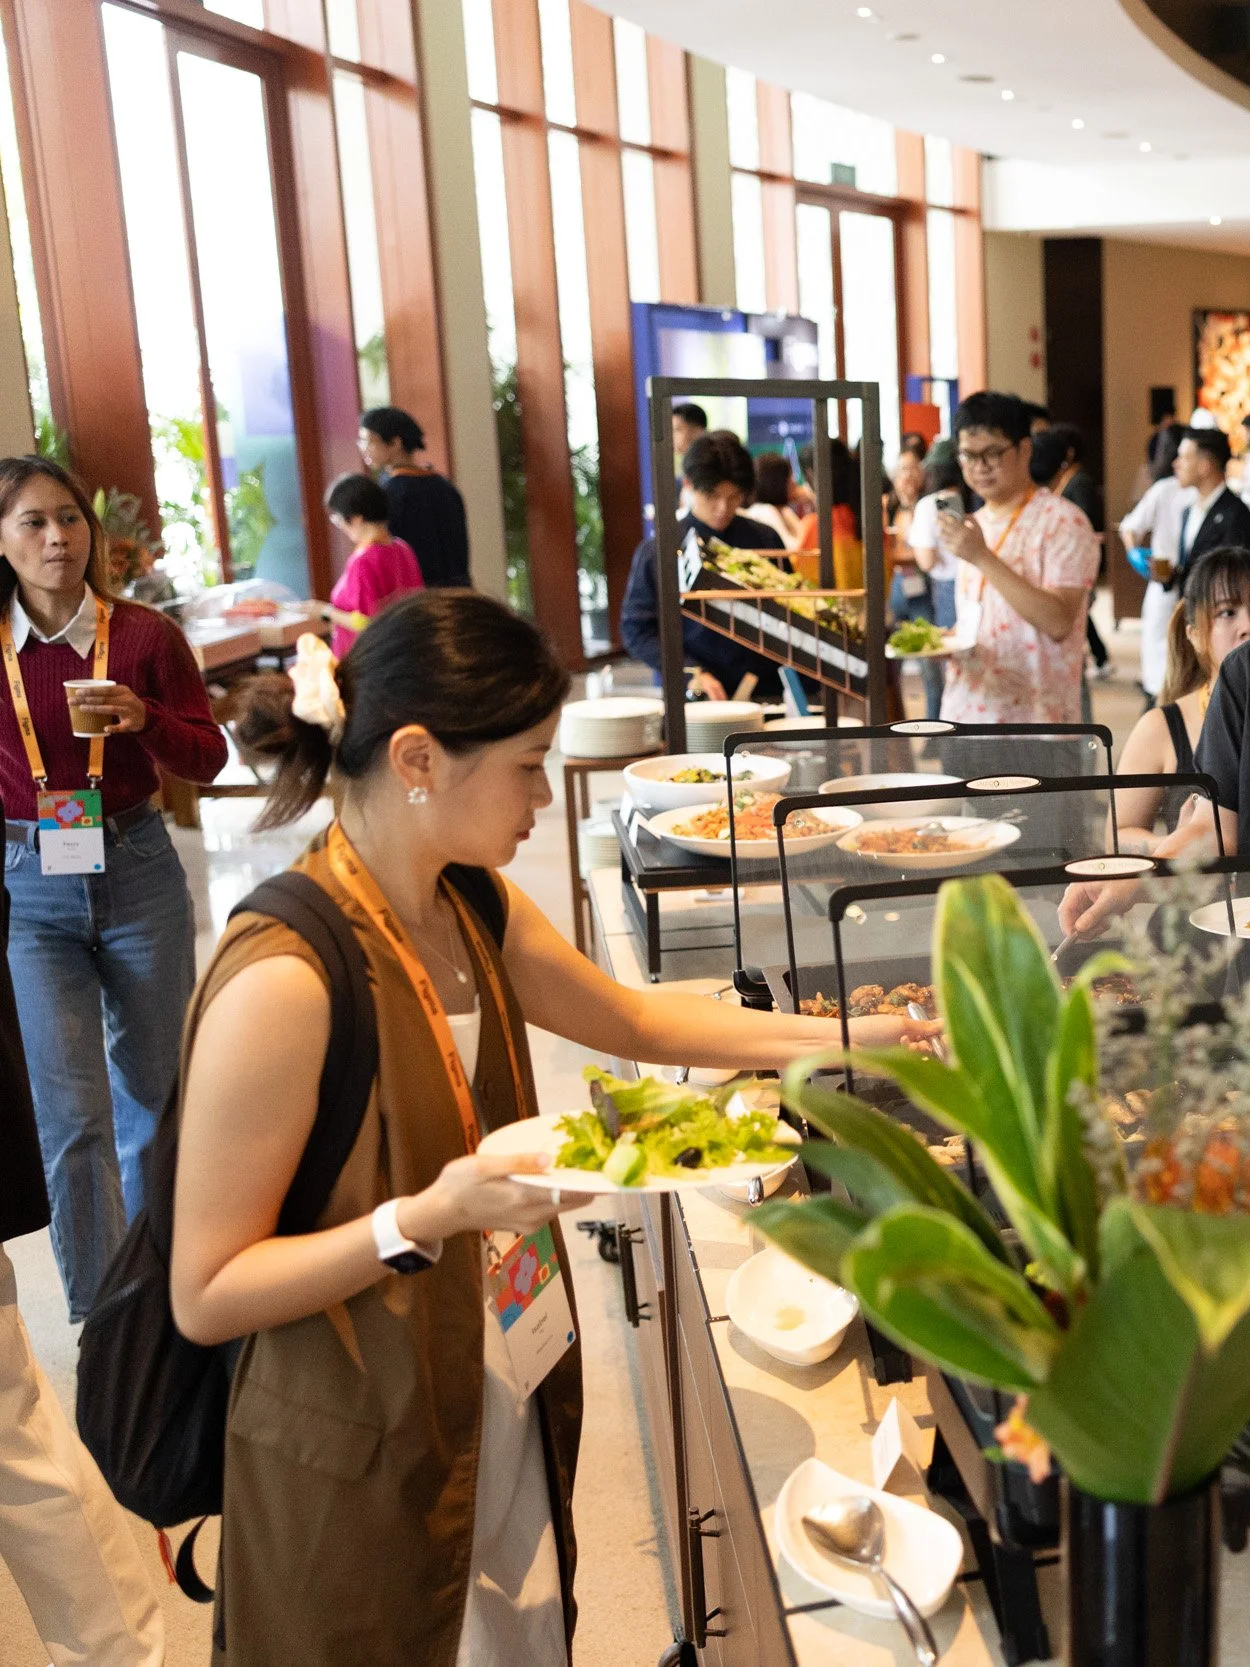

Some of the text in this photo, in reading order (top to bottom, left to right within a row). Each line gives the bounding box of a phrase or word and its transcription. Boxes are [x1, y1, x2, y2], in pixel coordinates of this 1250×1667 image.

[22, 717, 30, 737] Figma
[378, 908, 403, 942] Figma
[419, 978, 438, 1016] Figma
[448, 1051, 462, 1088] Figma
